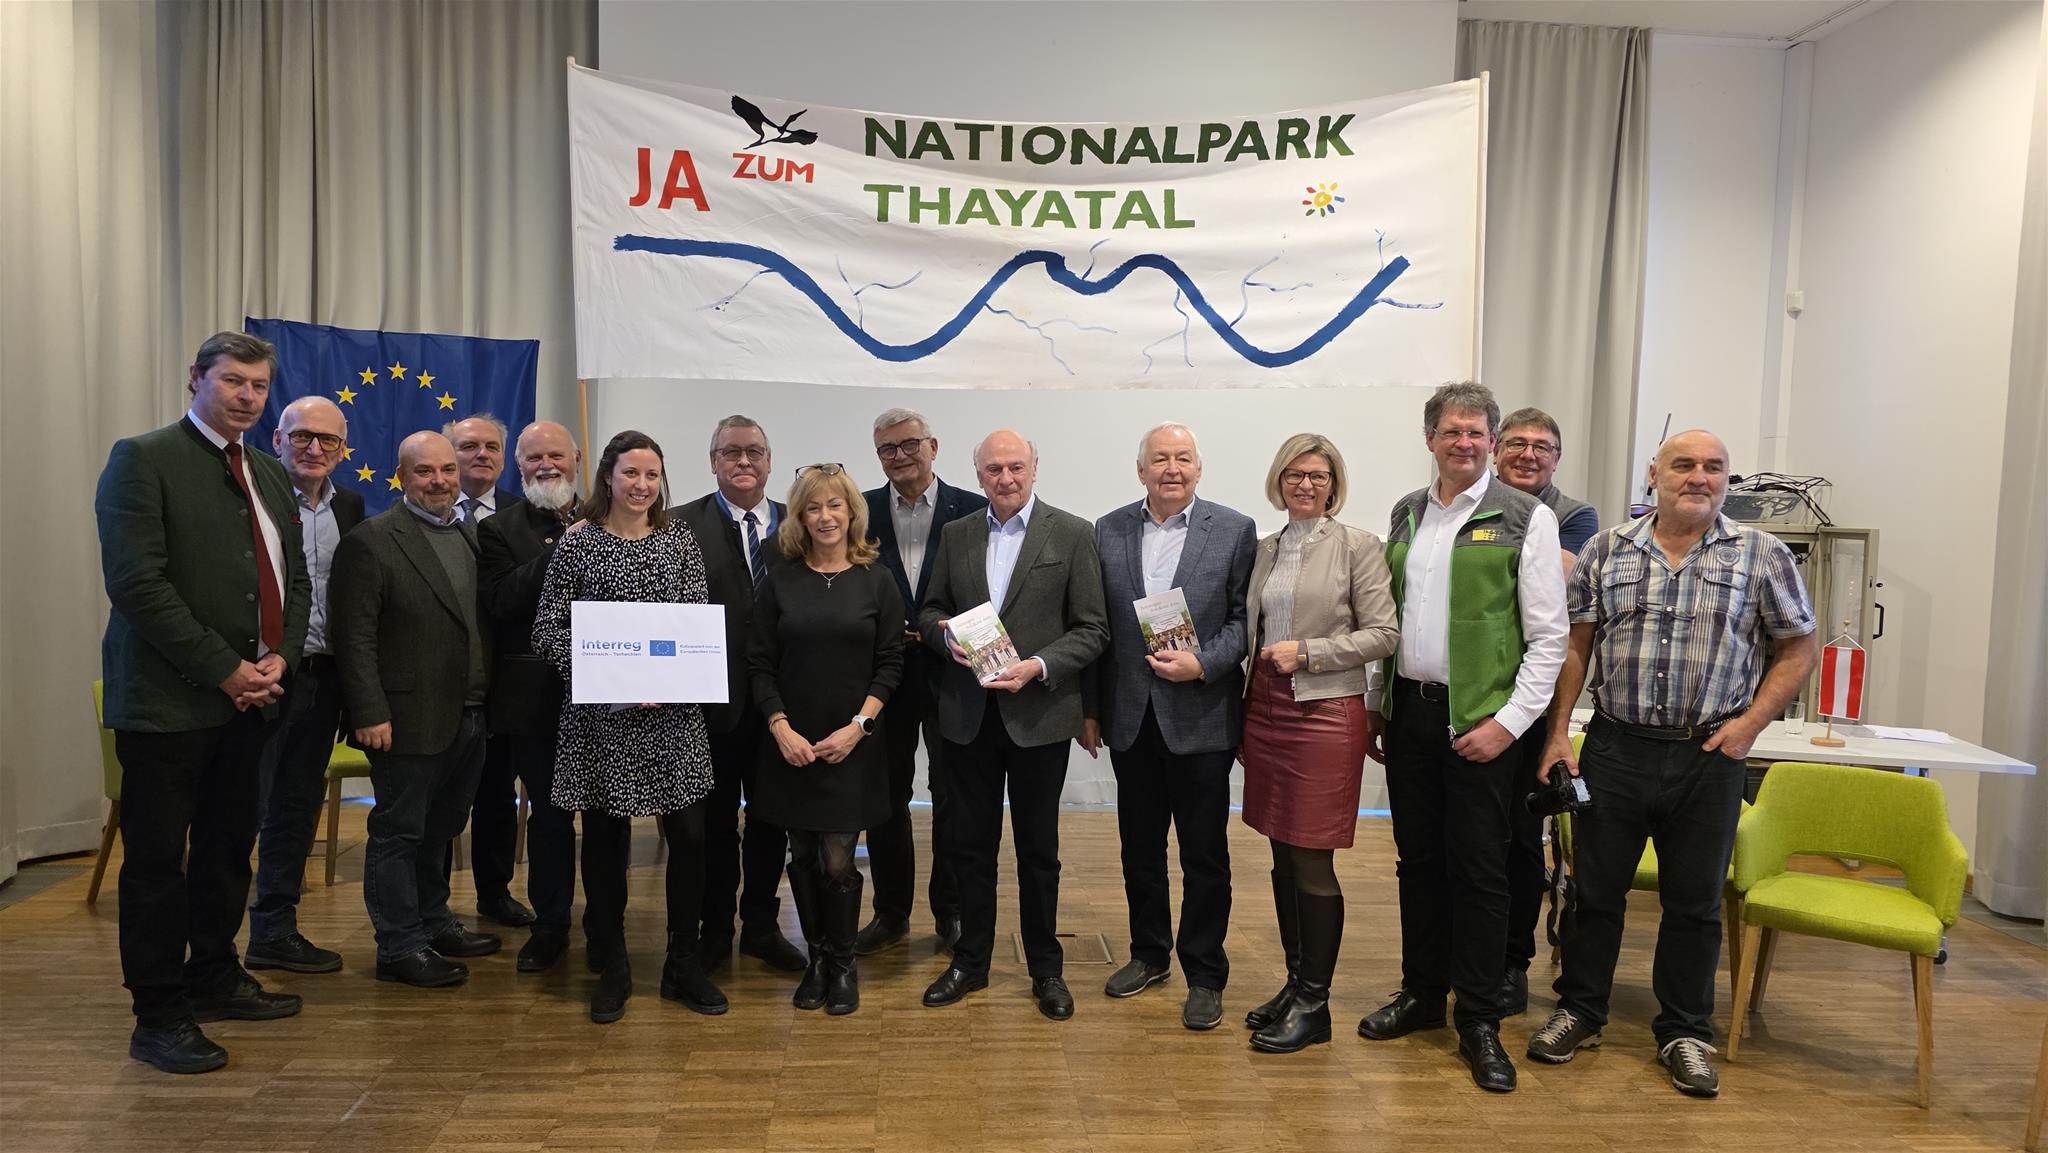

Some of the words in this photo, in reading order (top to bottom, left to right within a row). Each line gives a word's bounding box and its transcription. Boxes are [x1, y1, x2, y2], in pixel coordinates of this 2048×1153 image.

[864, 113, 1356, 165] NATIONALPARK
[629, 147, 710, 212] JA
[732, 153, 815, 184] ZUM
[863, 184, 1195, 229] THAYATAL
[582, 639, 642, 652] Interreg
